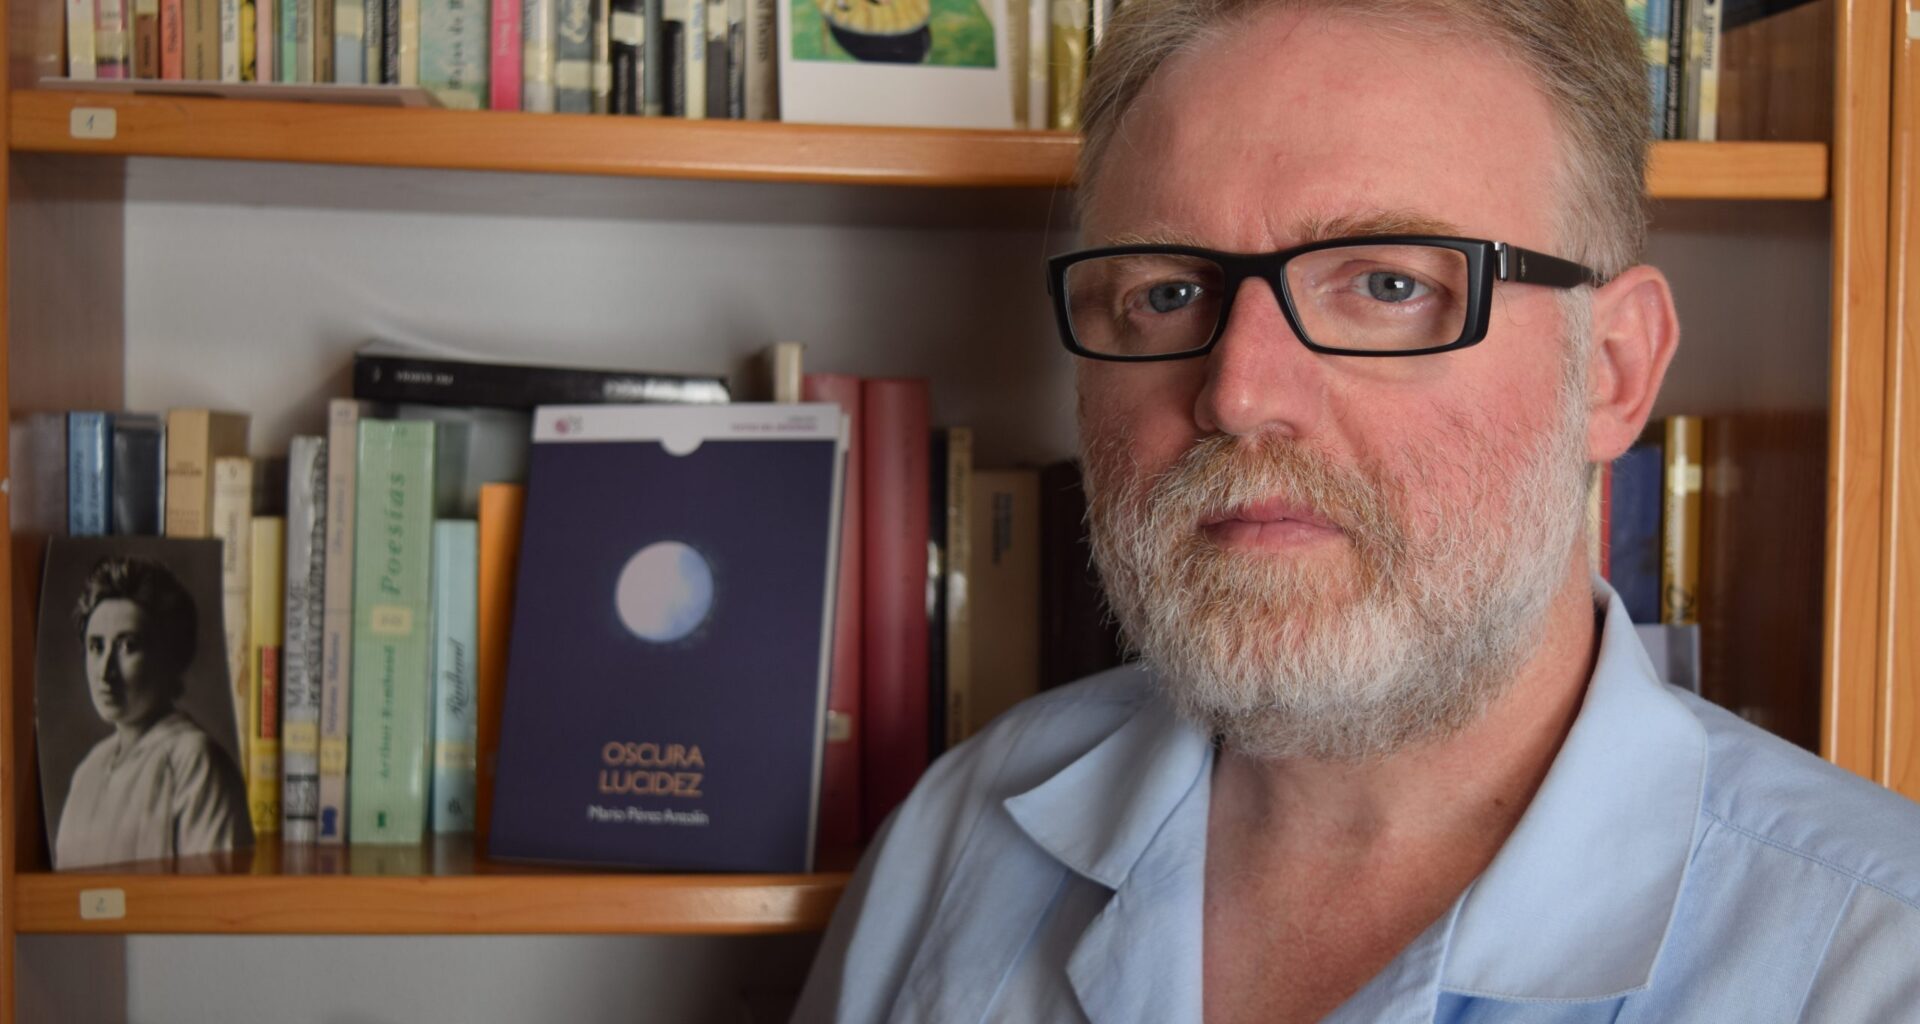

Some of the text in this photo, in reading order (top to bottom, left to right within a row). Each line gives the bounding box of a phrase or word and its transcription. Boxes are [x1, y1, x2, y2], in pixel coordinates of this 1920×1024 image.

[85, 114, 95, 131] 1
[380, 473, 406, 596] Poesías
[379, 645, 394, 779] Arthur Rimbaud
[602, 740, 705, 767] OSCURA
[598, 768, 704, 798] LUCIDEZ
[587, 804, 626, 822] Mario
[626, 805, 663, 823] Pérez
